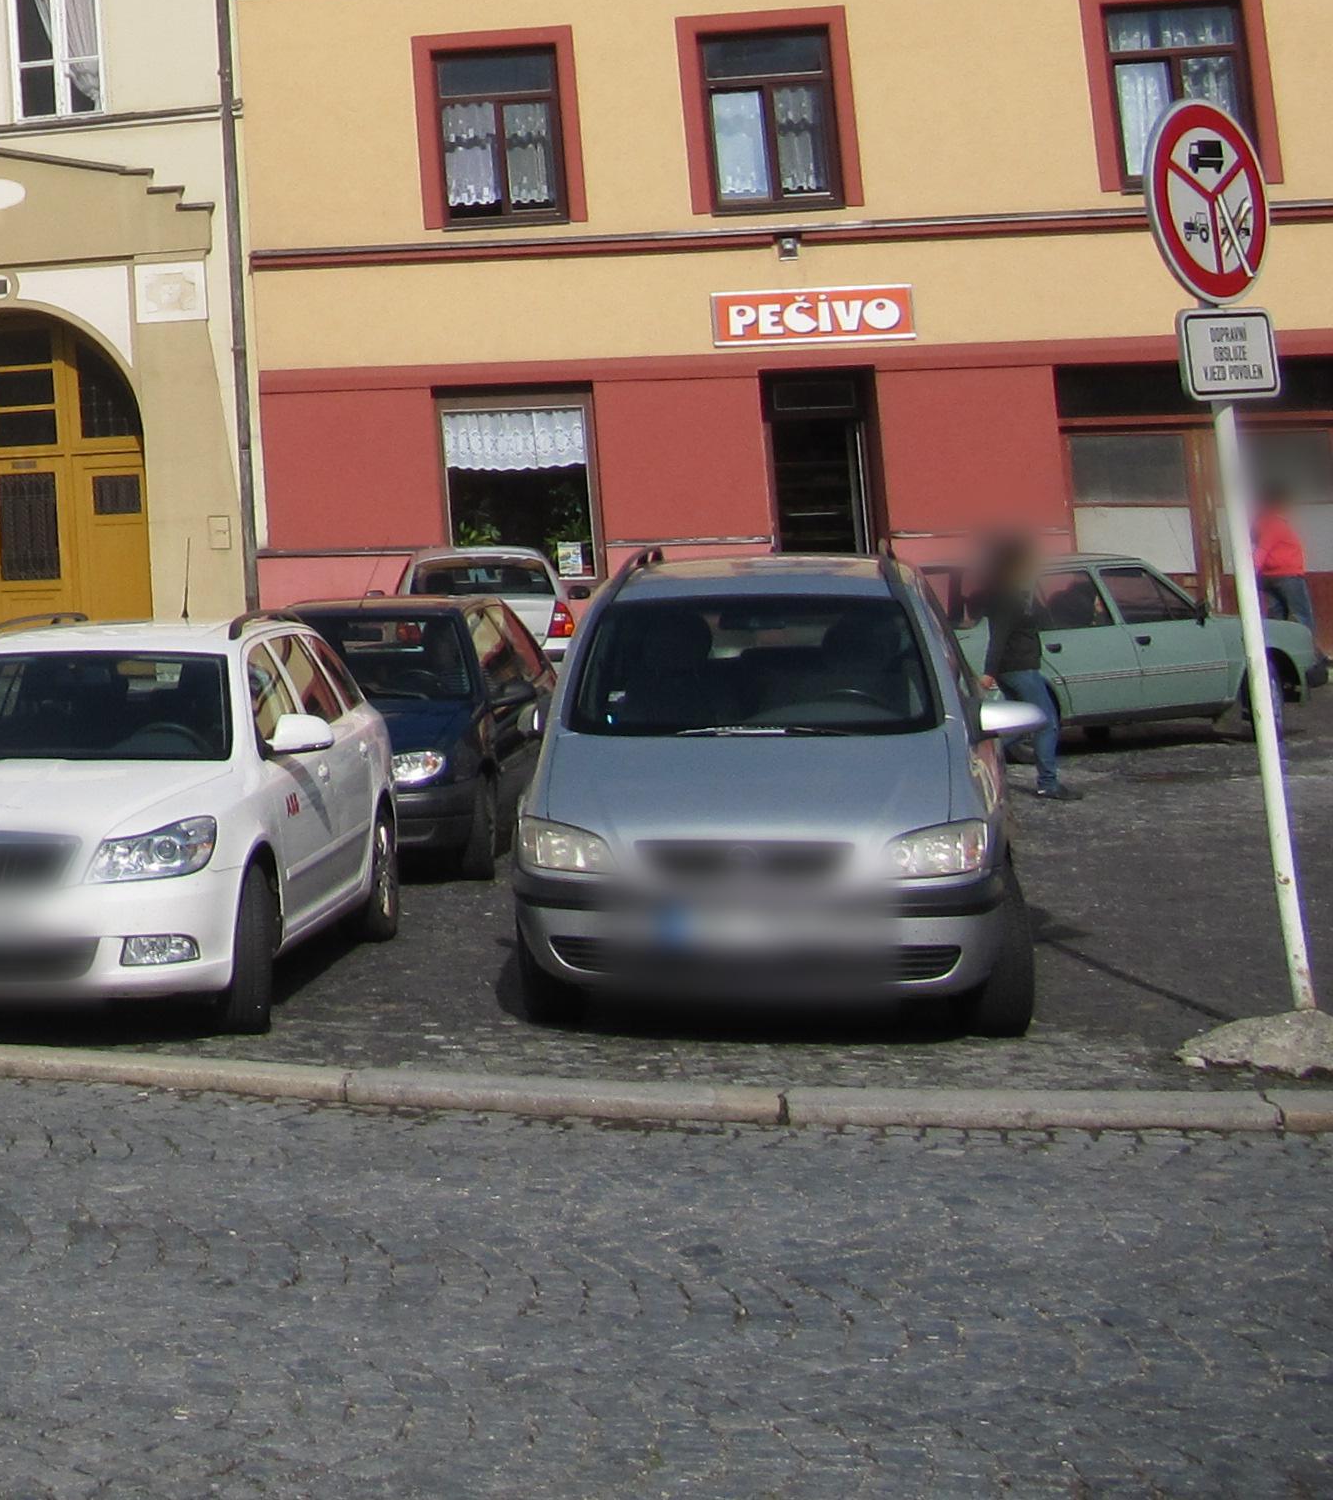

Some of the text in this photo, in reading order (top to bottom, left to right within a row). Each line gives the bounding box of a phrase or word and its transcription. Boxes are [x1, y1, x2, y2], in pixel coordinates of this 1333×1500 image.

[1209, 322, 1247, 342] DOPRAVNÍ
[1213, 345, 1248, 362] OBSLUZE
[1202, 364, 1263, 381] VJEZD POVOLEN
[286, 792, 300, 817] ABB
